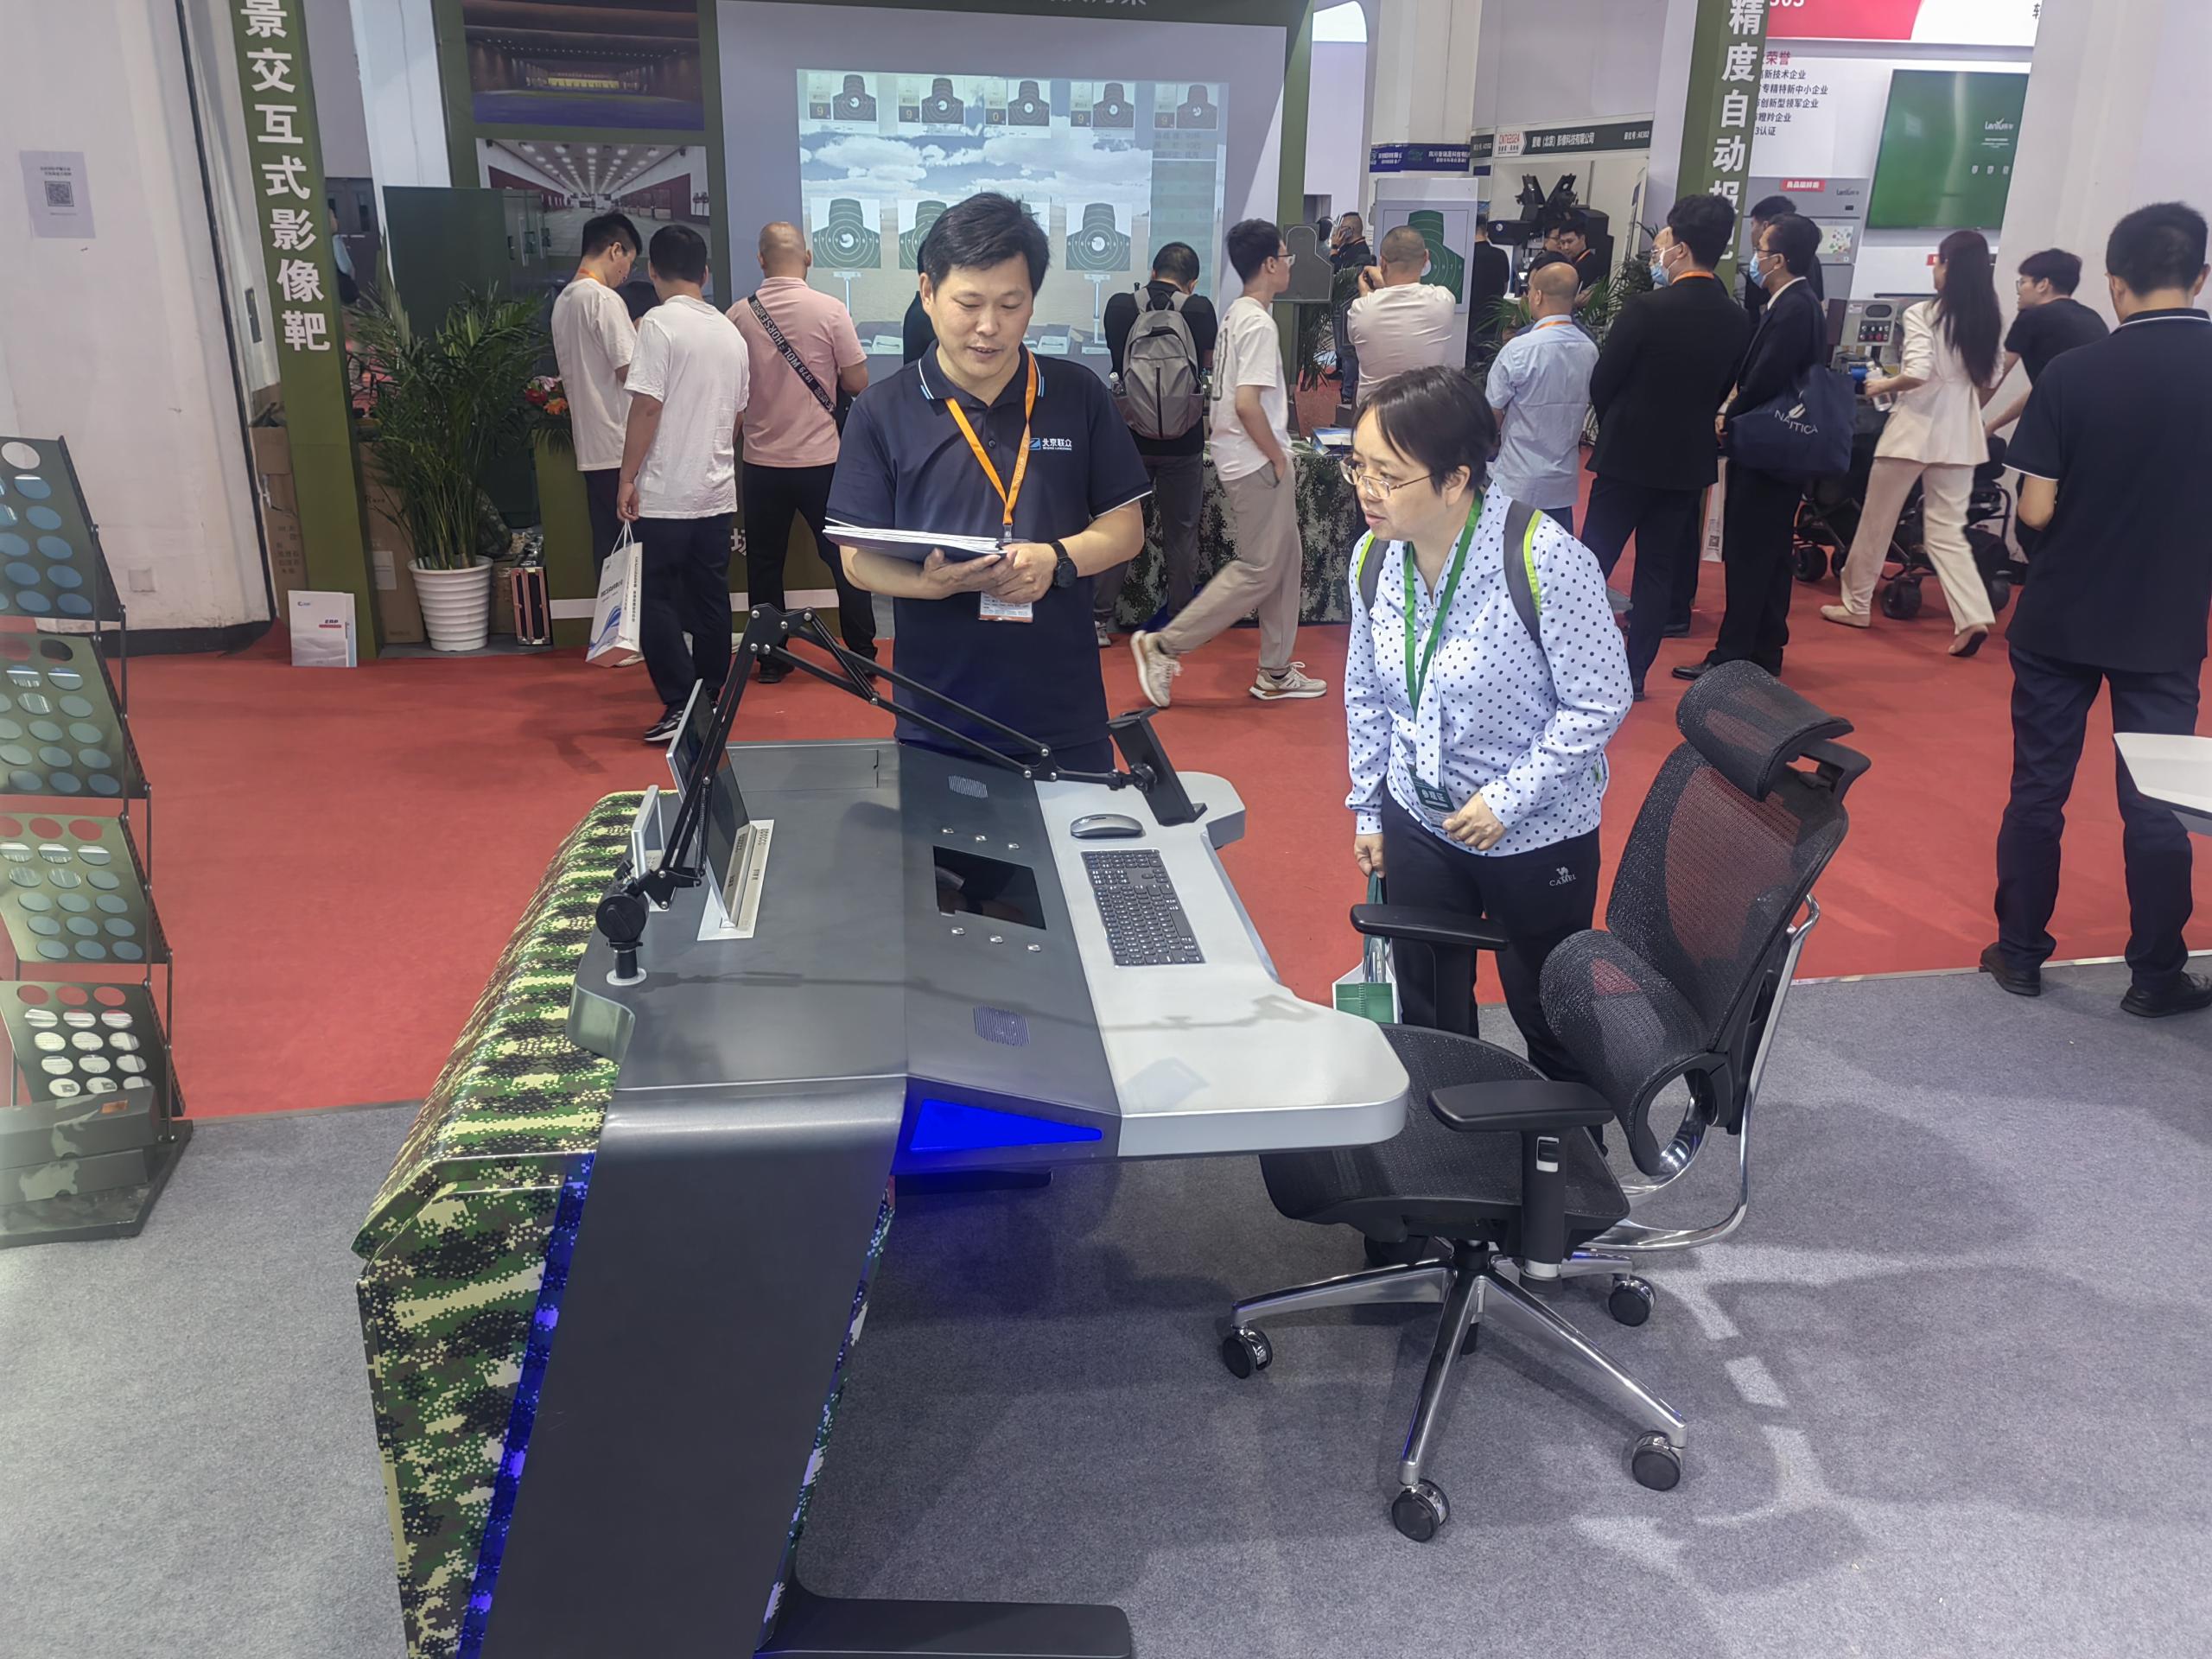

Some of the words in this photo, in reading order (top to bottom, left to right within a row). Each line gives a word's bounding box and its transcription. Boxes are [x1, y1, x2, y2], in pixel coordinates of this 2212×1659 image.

[1762, 51, 1791, 66] 荣誉
[1709, 0, 1764, 259] 精度自动报
[240, 0, 330, 352] 景交互式影像靶
[1042, 437, 1072, 448] 北京联众
[1549, 874, 1577, 887] CAMEL
